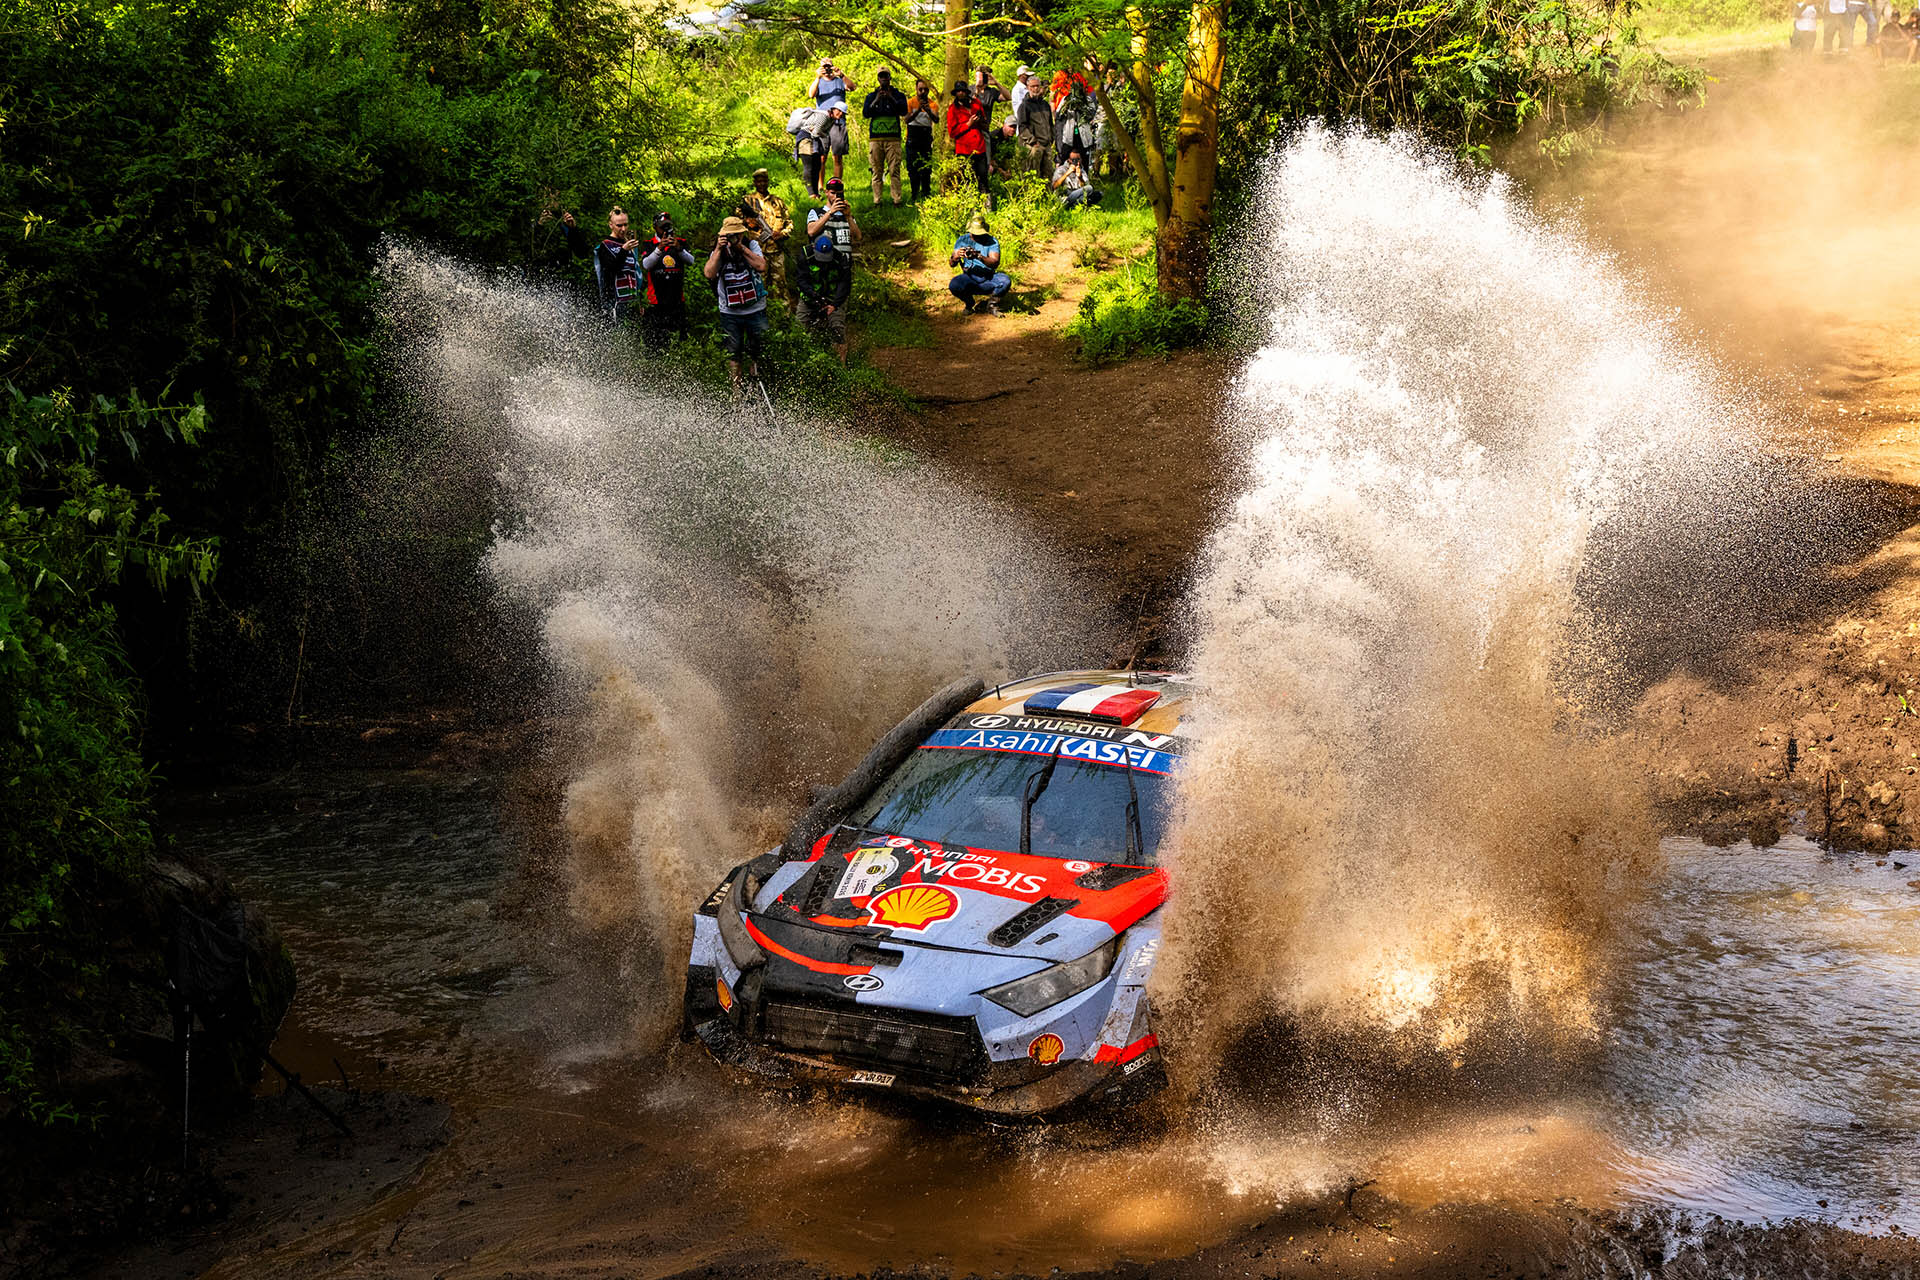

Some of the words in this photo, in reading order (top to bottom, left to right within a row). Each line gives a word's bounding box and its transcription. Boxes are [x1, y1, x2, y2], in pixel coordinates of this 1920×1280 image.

[1014, 717, 1115, 739] HYUNDAI
[905, 847, 998, 865] HYUNDAI
[908, 857, 1047, 893] MOBIS
[1123, 1053, 1152, 1074] sparco
